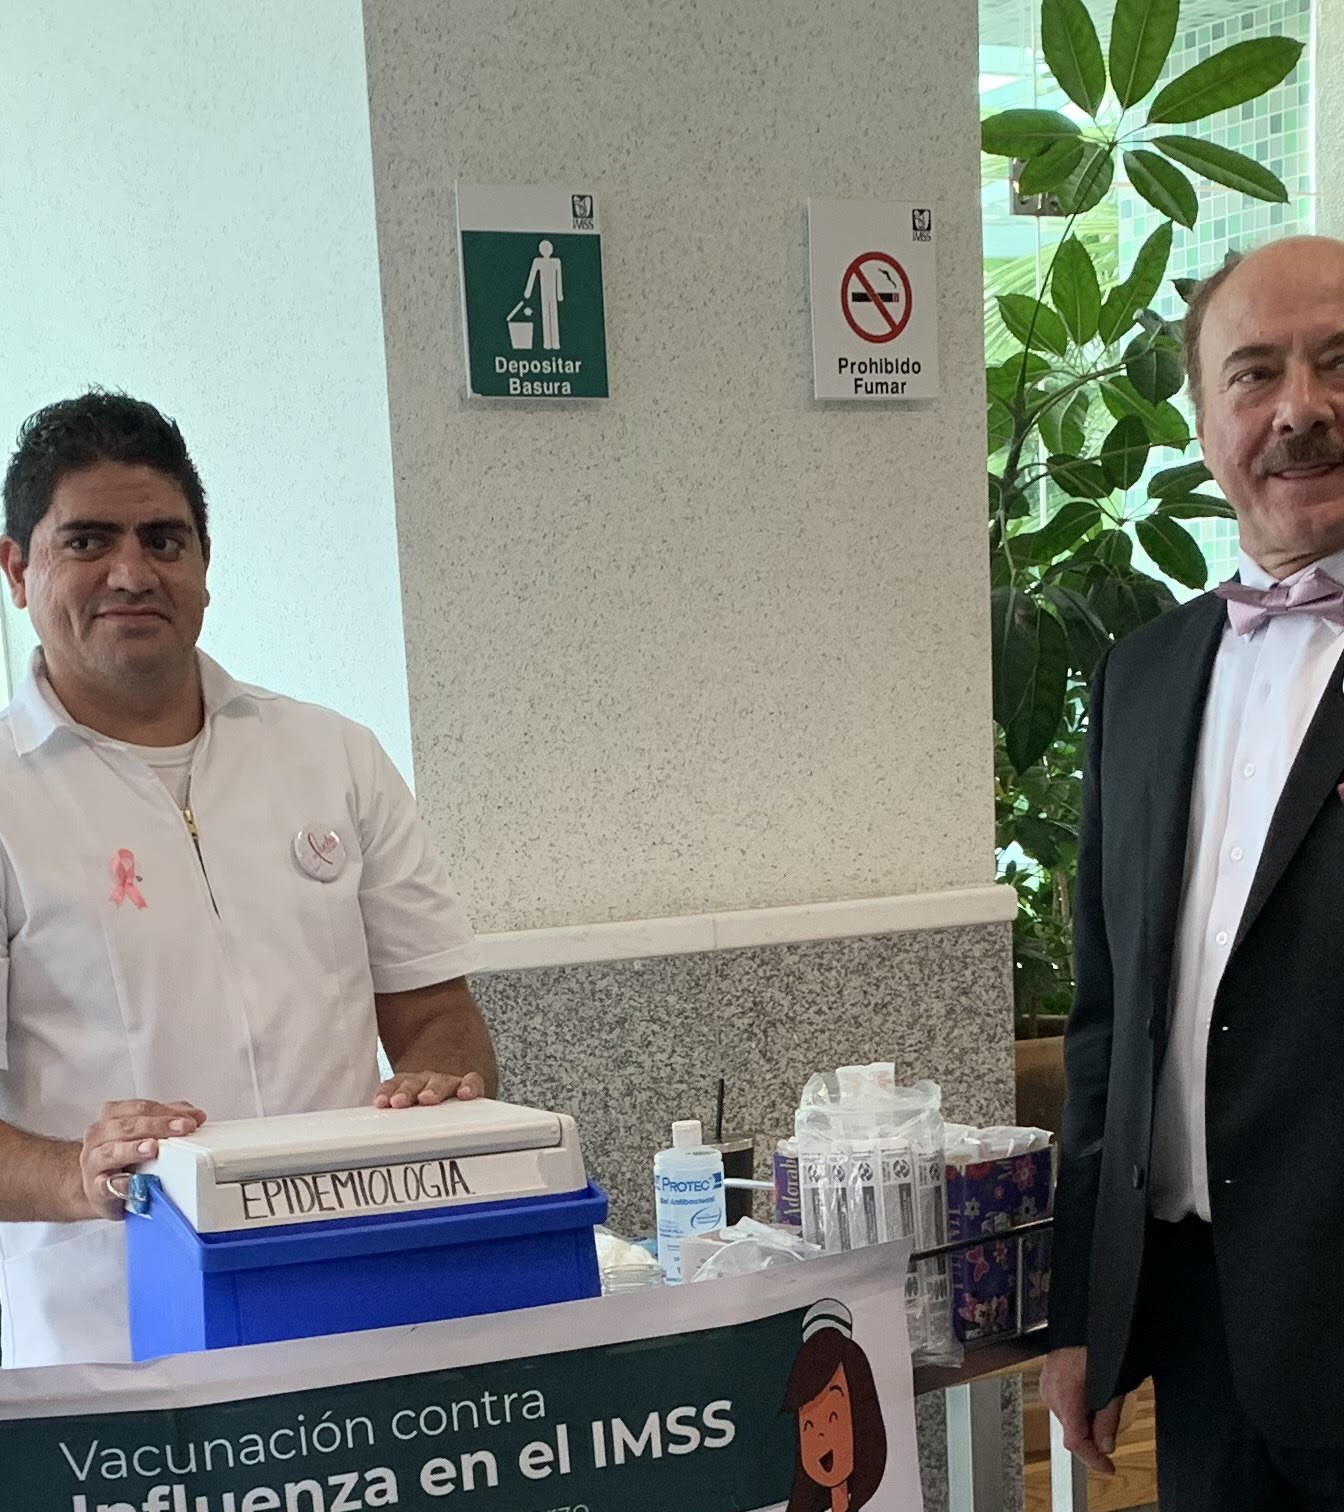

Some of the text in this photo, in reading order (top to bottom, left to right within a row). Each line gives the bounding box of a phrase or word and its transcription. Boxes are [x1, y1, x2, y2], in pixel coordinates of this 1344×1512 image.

[495, 356, 582, 377] Depositar
[838, 357, 921, 374] Prohibido
[509, 378, 571, 395] Basura
[854, 378, 907, 394] Fumar
[59, 1389, 545, 1481] Vacunación contra
[419, 1449, 498, 1496] en
[519, 1423, 572, 1480] el
[592, 1400, 736, 1468] IMSS
